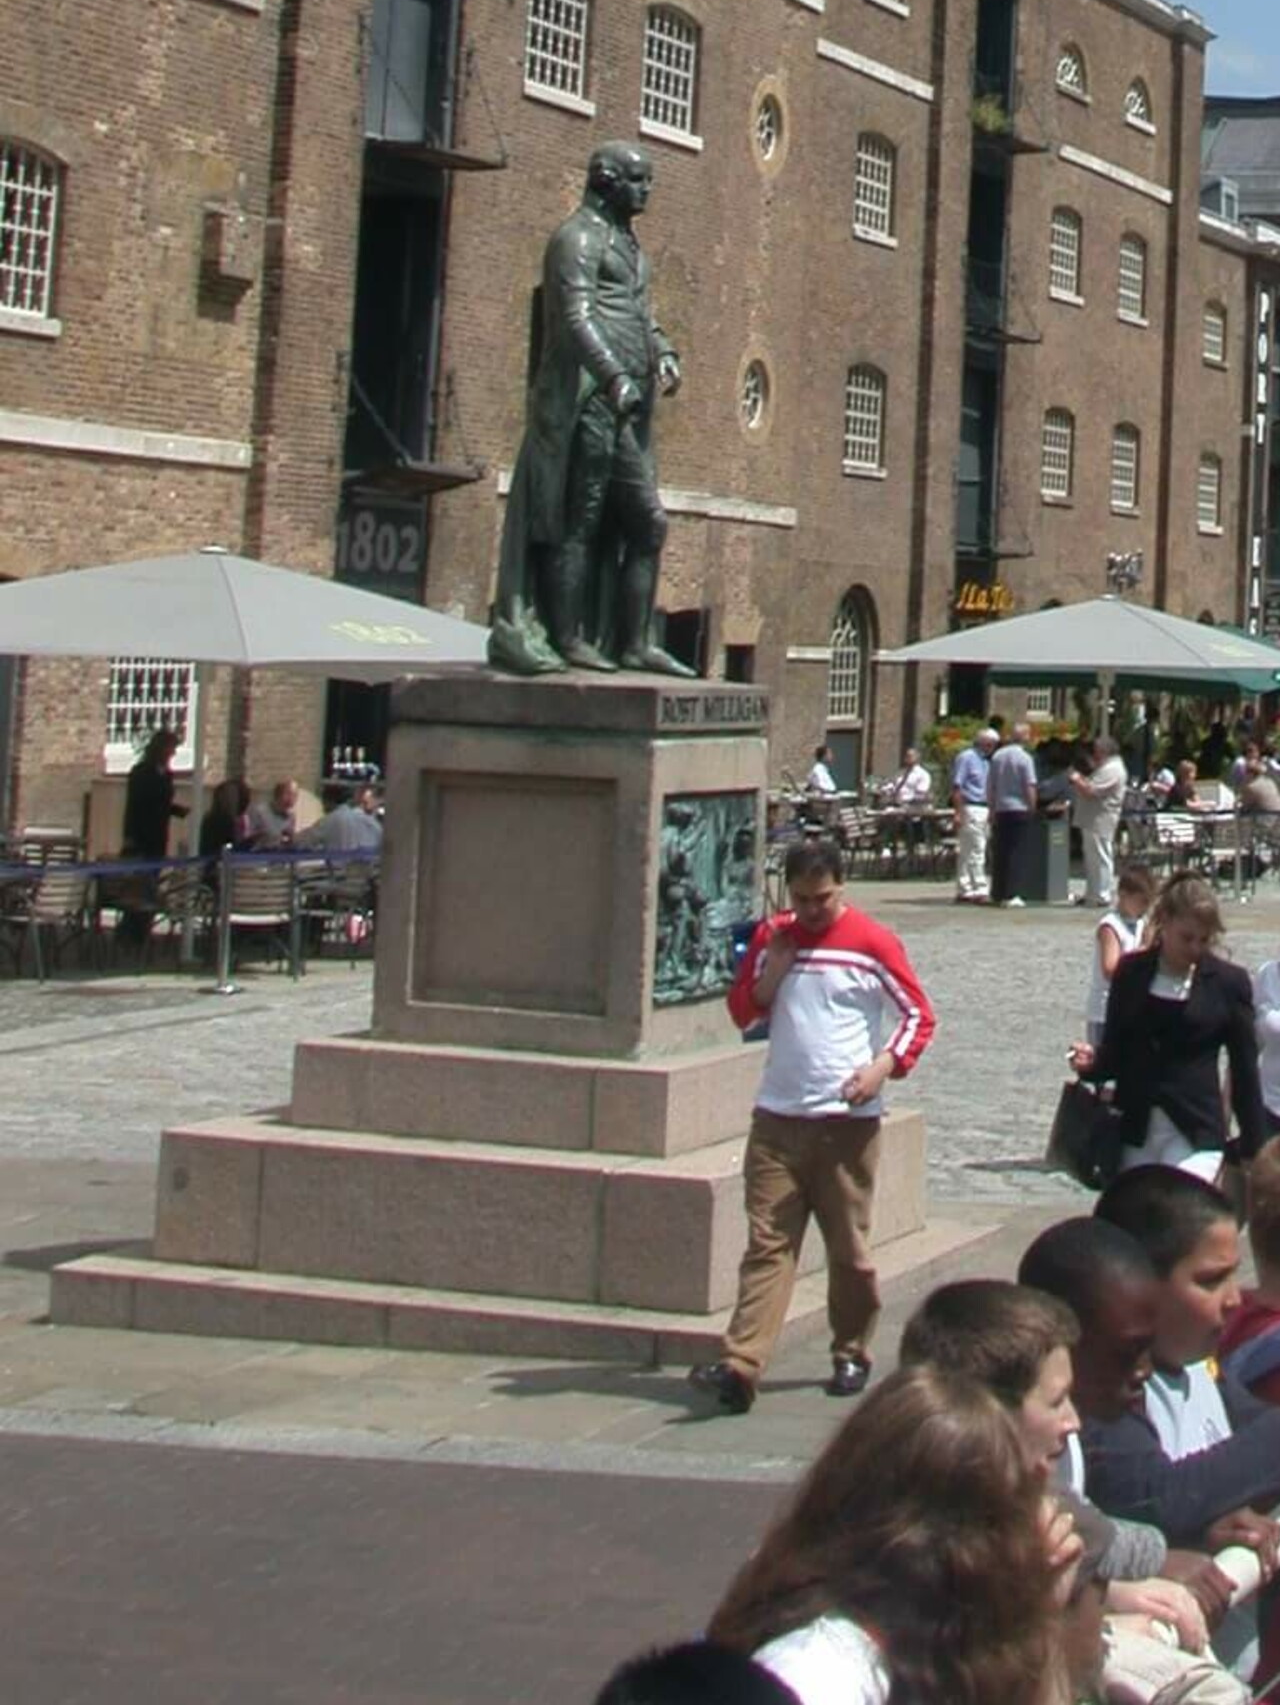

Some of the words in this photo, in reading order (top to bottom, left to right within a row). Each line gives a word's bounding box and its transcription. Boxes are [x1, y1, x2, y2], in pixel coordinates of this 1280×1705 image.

[1256, 291, 1270, 444] PORT
[338, 509, 420, 573] 1802
[703, 694, 769, 724] MILLIGAN
